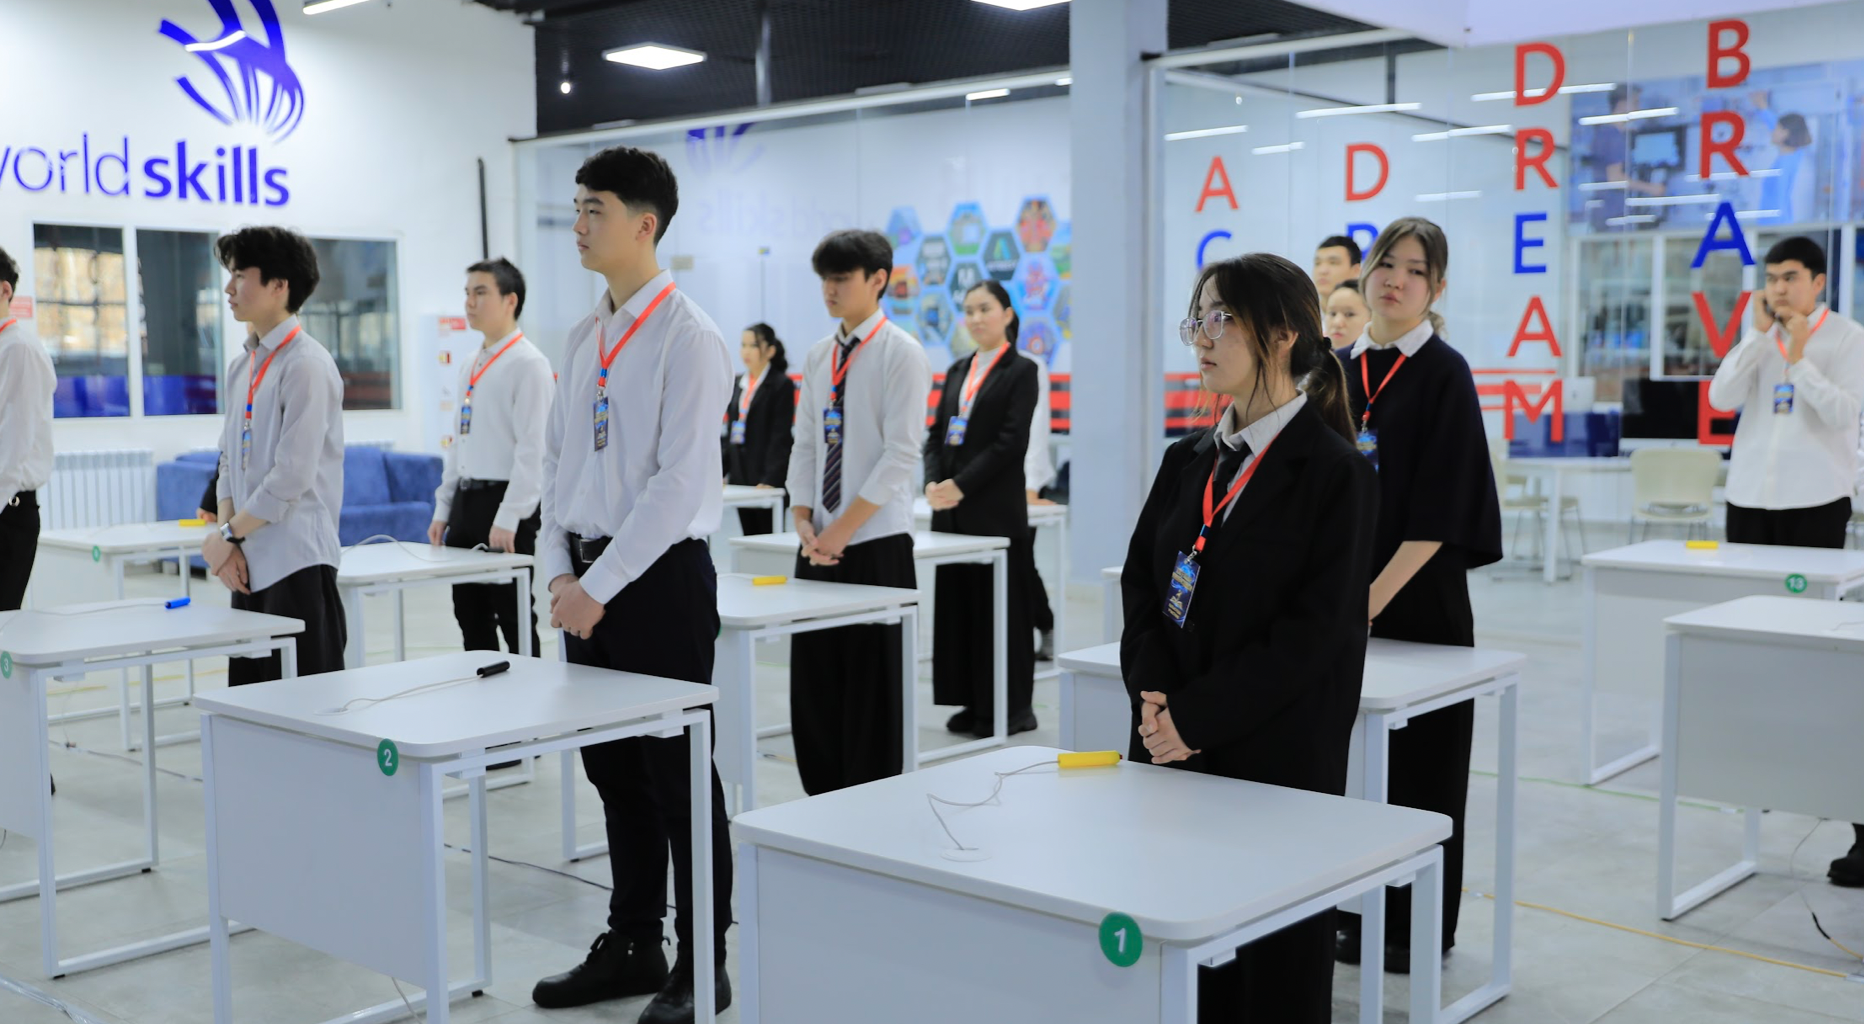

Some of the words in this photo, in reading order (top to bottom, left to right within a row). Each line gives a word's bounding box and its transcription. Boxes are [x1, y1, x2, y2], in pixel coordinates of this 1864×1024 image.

[0, 133, 130, 196] orld
[143, 138, 291, 207] skills
[1506, 42, 1567, 443] DREAM
[1690, 19, 1757, 446] BRAVE
[383, 748, 393, 767] 2
[1114, 927, 1126, 953] 1
